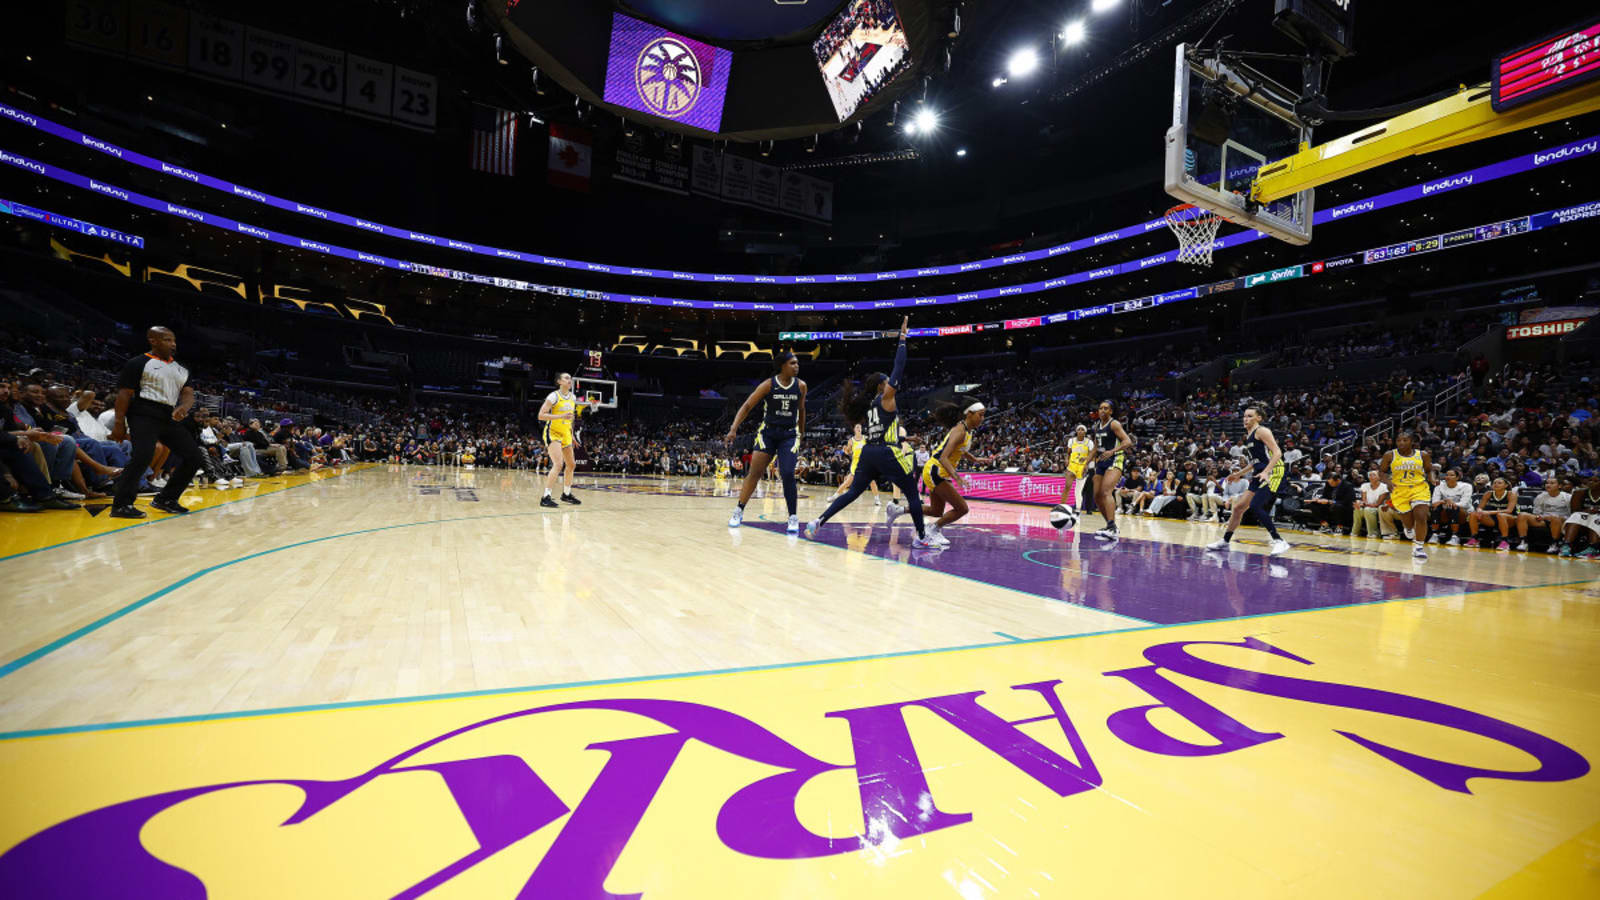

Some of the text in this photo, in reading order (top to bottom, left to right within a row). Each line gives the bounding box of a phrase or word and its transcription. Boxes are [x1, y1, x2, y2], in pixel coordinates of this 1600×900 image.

[201, 36, 232, 67] 18
[250, 51, 289, 80] 99
[302, 63, 338, 92] 20
[360, 79, 379, 104] 4
[400, 90, 431, 117] 23
[1534, 141, 1597, 165] lendistry
[1422, 174, 1473, 195] lendistry
[1332, 200, 1374, 218] lendistry
[52, 216, 79, 229] ULTRA
[101, 229, 140, 246] DELTA
[1326, 258, 1354, 269] TOYOTA
[1270, 268, 1297, 282] Sprite
[781, 400, 790, 410] 15
[1032, 481, 1064, 496] MIELL
